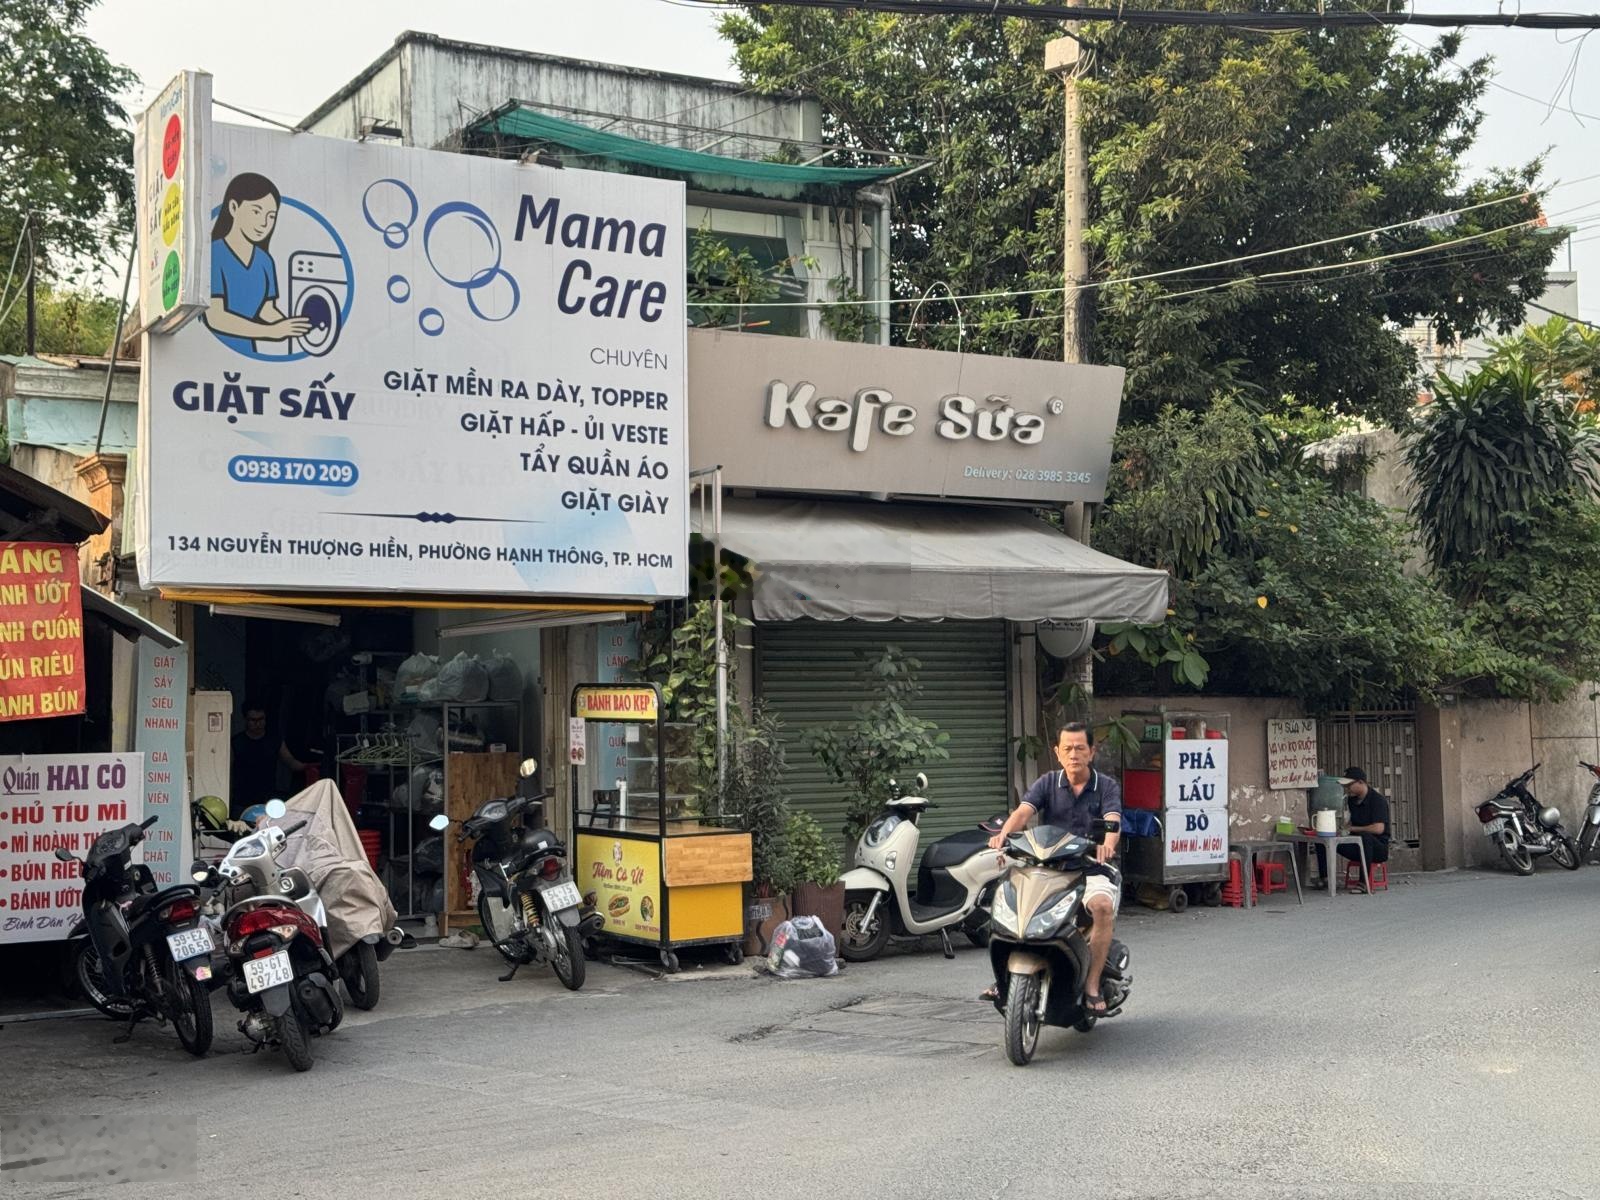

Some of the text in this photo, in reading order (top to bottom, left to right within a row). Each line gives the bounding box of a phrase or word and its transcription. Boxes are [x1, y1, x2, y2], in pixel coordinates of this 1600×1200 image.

[514, 194, 666, 257] Mama
[557, 259, 666, 322] Care
[590, 347, 668, 370] CHUYÊN
[172, 371, 270, 424] GIẶT
[279, 372, 356, 421] SẤY
[383, 367, 668, 410] GIẶT MỀN RA DÀY, TOPPER
[460, 410, 513, 438] GIẶT
[520, 411, 565, 437] HẤP
[585, 415, 604, 440] ỦI
[612, 423, 668, 445] VESTE
[764, 379, 918, 453] Kafe
[935, 394, 1045, 444] Sữa
[234, 459, 352, 482] 0938 170 209
[520, 443, 560, 472] TẨY
[567, 448, 630, 477] QUẦN
[637, 455, 668, 479] ÁO
[963, 465, 1092, 484] Delivery: 028 3985 3345
[561, 488, 669, 516] GIẶT GIÀY
[0, 543, 64, 574] ÁNG
[168, 532, 673, 568] 134 NGUYỄN THƯỢNG HIỀN, PHƯỜNG HẠNH THÔNG, TP. HCM
[35, 577, 72, 605] ƯỚT
[32, 610, 81, 641] CUỐN
[0, 650, 75, 680] ÚN RIÊU
[0, 685, 78, 716] ANH BÚN
[587, 691, 611, 711] BÁNH
[613, 694, 631, 711] BAO
[144, 717, 179, 729] NHANH
[1179, 747, 1215, 769] PHÁ
[3, 758, 126, 795] Quán HAI CÒ
[147, 771, 171, 784] SINH
[1179, 776, 1215, 801] LẤU
[11, 799, 127, 825] HỦ TÍU MÌ
[1185, 809, 1209, 831] BÒ
[11, 831, 29, 853] MÌ
[33, 830, 79, 852] HOÀNH
[11, 860, 46, 882] BÚN
[10, 886, 82, 910] BÁNH ƯỚT
